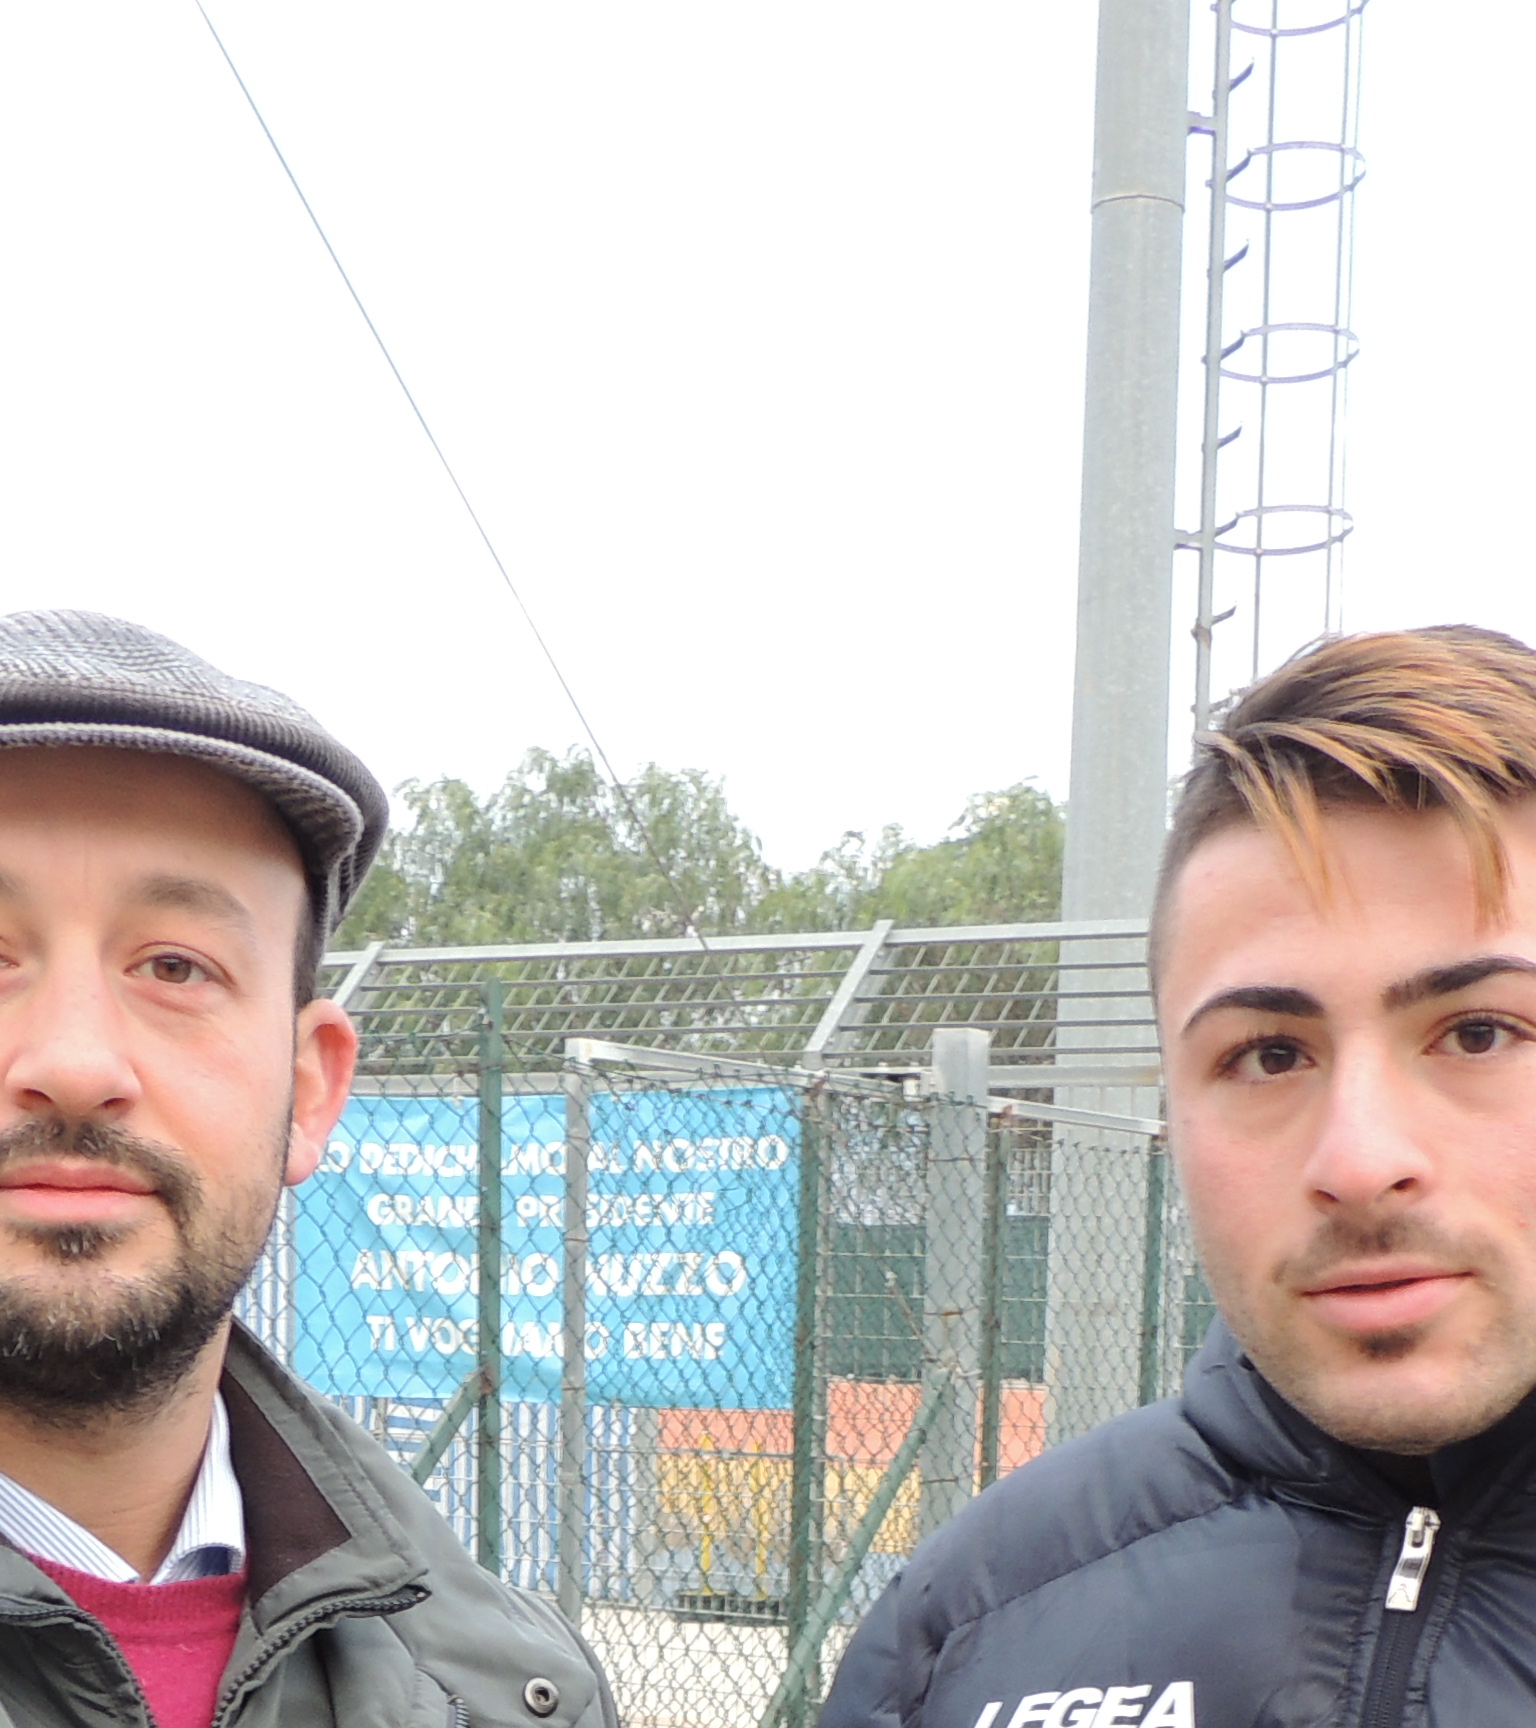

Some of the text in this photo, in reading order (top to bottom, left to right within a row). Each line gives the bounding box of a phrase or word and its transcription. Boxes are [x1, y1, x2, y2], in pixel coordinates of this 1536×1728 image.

[359, 1141, 568, 1177] DEDICHMO
[633, 1134, 790, 1174] NOSTRO
[516, 1191, 715, 1228] PRSIDENTE
[366, 1315, 396, 1351] TI
[405, 1316, 610, 1360] VOGIAMO
